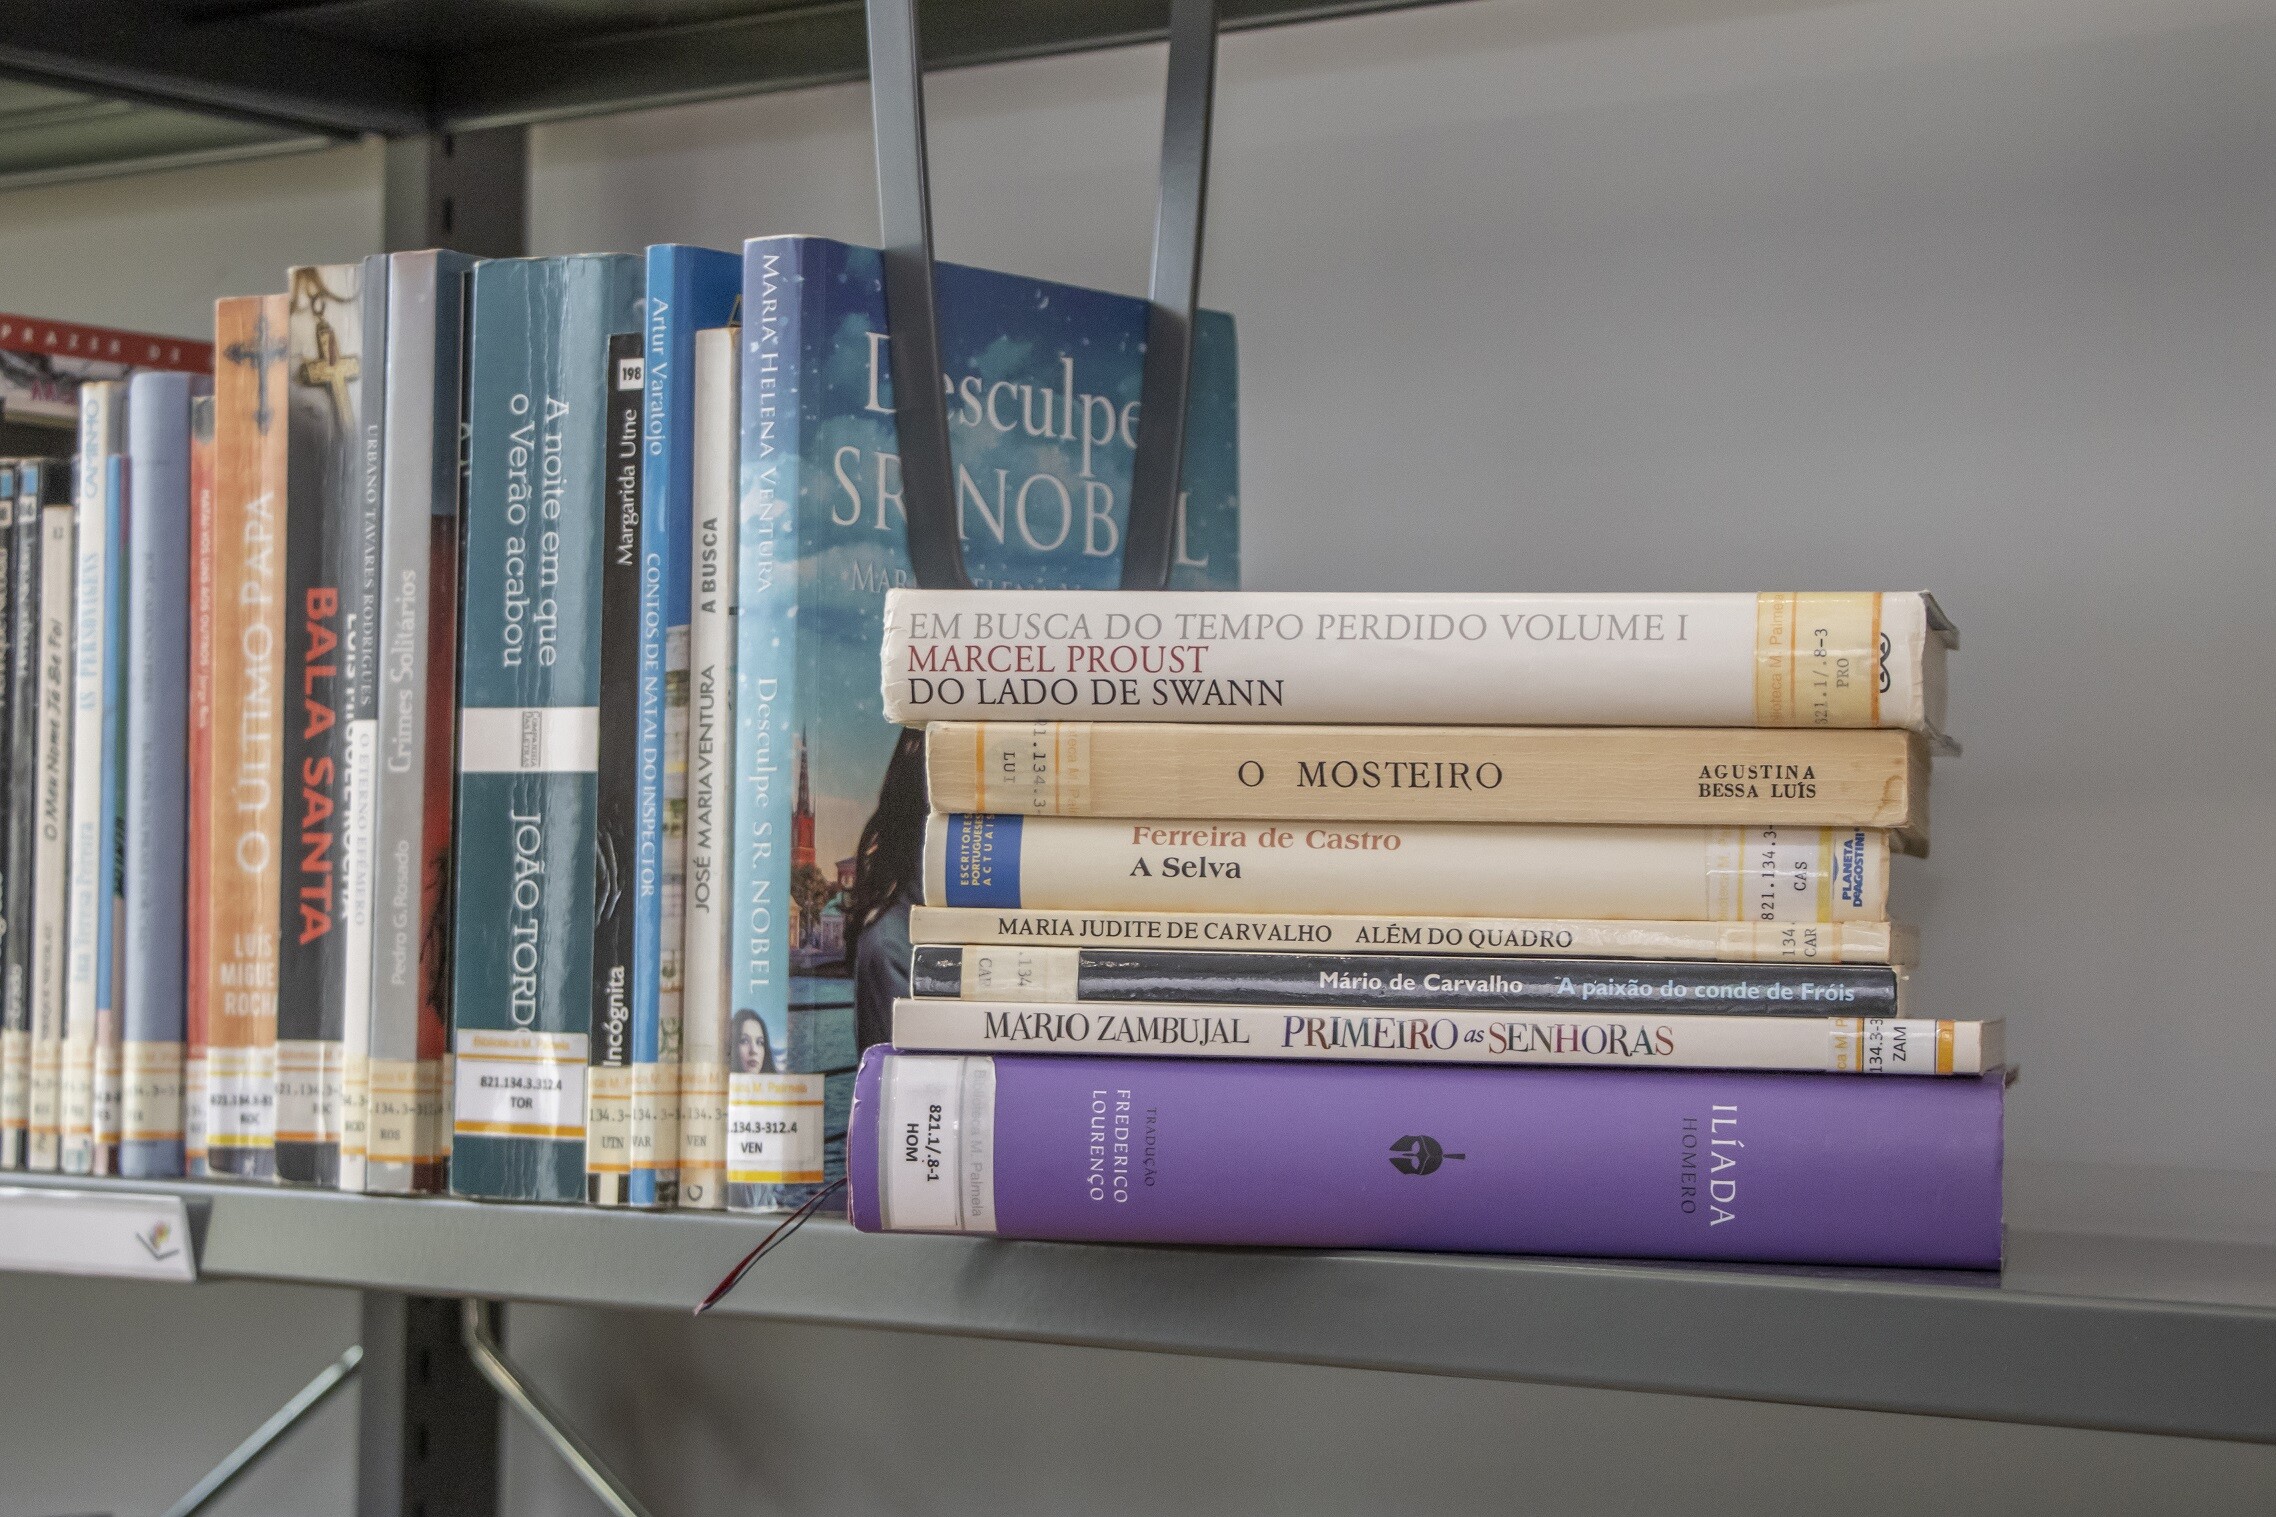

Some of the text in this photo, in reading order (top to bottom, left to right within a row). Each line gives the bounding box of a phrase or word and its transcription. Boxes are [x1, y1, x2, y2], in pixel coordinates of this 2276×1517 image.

[621, 365, 642, 382] 198
[645, 296, 669, 457] Artur Varatojo
[82, 398, 99, 500] CAMINHO
[616, 408, 640, 567] Margarida Utne
[956, 462, 1210, 568] NOBL
[502, 393, 536, 668] o Verão acabou
[533, 394, 571, 667] A noite em que
[358, 423, 379, 707] URBANO TAVARES RODRIGUES
[700, 516, 719, 615] A BUSCA
[907, 644, 1210, 674] MARCEL PROUST
[908, 612, 1689, 642] EM BUSCA DO TEMPO PERDIDO VOLUME I
[230, 490, 275, 874] O ÚLTIMO PAPA
[387, 568, 417, 774] Crimes Solitários
[907, 677, 1286, 708] DO LADO DE SWANN
[1836, 657, 1850, 689] PRO
[640, 552, 661, 898] CONTOS DE NATAL DO INSPECTOR
[297, 586, 340, 945] BALA SANTA
[356, 753, 371, 831] ETERNO
[692, 664, 717, 915] JOSÉ MARIA VENTURA
[1002, 751, 1016, 784] LUI
[1237, 760, 1504, 792] O MOSTEIRO
[1698, 764, 1816, 780] AGUSTINA
[1698, 781, 1817, 799] BESSA LUÍS
[747, 677, 779, 994] Desculpe SR. NOBEL
[959, 814, 973, 886] ESCRITORES
[970, 814, 985, 887] PORTUGUESES
[982, 814, 995, 887] ACTUAIS
[1129, 856, 1242, 879] A Selva
[1131, 825, 1402, 852] Ferreira de Castro
[392, 839, 411, 907] Rosado
[1793, 861, 1808, 892] CAS
[1841, 839, 1854, 901] PLANETA
[509, 809, 546, 1034] JOÃO TORD
[997, 917, 1574, 951] MARIA JUDITE DE CARVALHO ALÉM DO QUADRO
[1803, 927, 1818, 958] CAR
[219, 961, 275, 987] MIGUE
[391, 932, 409, 986] Pedro
[1318, 970, 1856, 1003] Mário de Carvalho A paixão do conde de Fróis
[602, 964, 629, 1068] Incógnita
[983, 1010, 1675, 1058] MÁRIO ZAMBUJAL PRIMEIRO as SENHORAS
[1892, 1025, 1907, 1063] ZAM
[479, 1075, 563, 1092] 821.134.3.312.4
[510, 1096, 534, 1110] TOR
[970, 1068, 987, 1137] Biblioteca
[601, 1135, 625, 1149] UTN
[631, 1134, 652, 1148] VAR
[686, 1134, 708, 1147] VEN
[740, 1141, 764, 1154] VEN
[904, 1122, 920, 1163] HOM
[924, 1103, 943, 1183] 821.1/.8-1
[1089, 1088, 1108, 1202] LOURENÇO
[1116, 1088, 1132, 1204] FREDERICO
[1145, 1106, 1158, 1188] TRADUÇÃO
[1680, 1116, 1698, 1216] HOMERO
[1709, 1104, 1739, 1228] ILÍADA
[969, 1162, 984, 1217] Palmela
